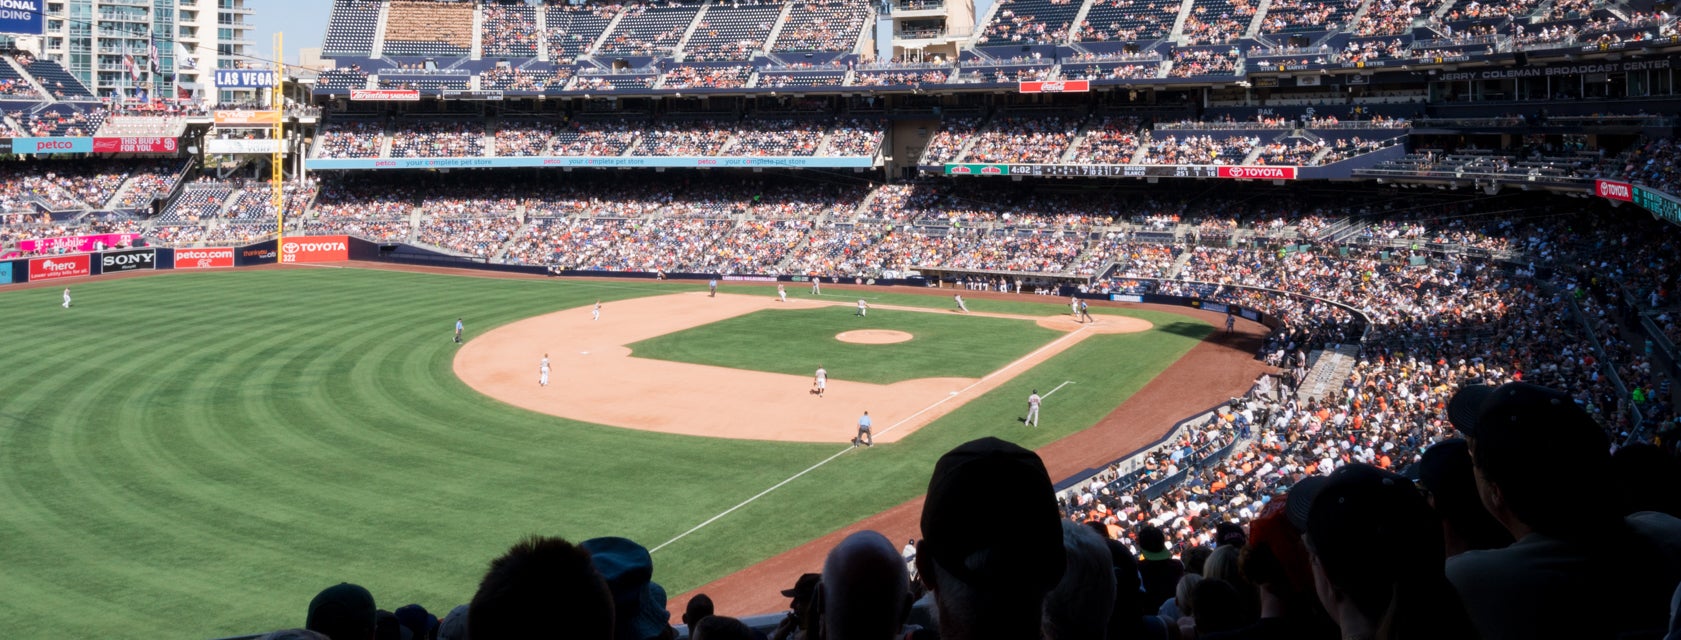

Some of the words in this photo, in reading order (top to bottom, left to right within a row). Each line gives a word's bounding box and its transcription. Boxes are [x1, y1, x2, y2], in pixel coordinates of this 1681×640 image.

[0, 10, 31, 20] DING
[1439, 72, 1477, 81] JERRY
[1482, 68, 1541, 80] COLEMAN
[1545, 63, 1620, 76] BROADCAST
[1623, 59, 1670, 71] CENTER
[217, 72, 239, 86] LAS
[242, 72, 279, 86] VEGAS
[36, 140, 73, 151] petco
[1244, 168, 1284, 177] TOYOTA
[1608, 184, 1629, 197] TOYOTA
[301, 242, 346, 251] TOYOTA
[103, 253, 154, 266] SONY
[176, 251, 233, 260] petco.com
[283, 254, 296, 262] 322
[51, 261, 76, 271] hero
